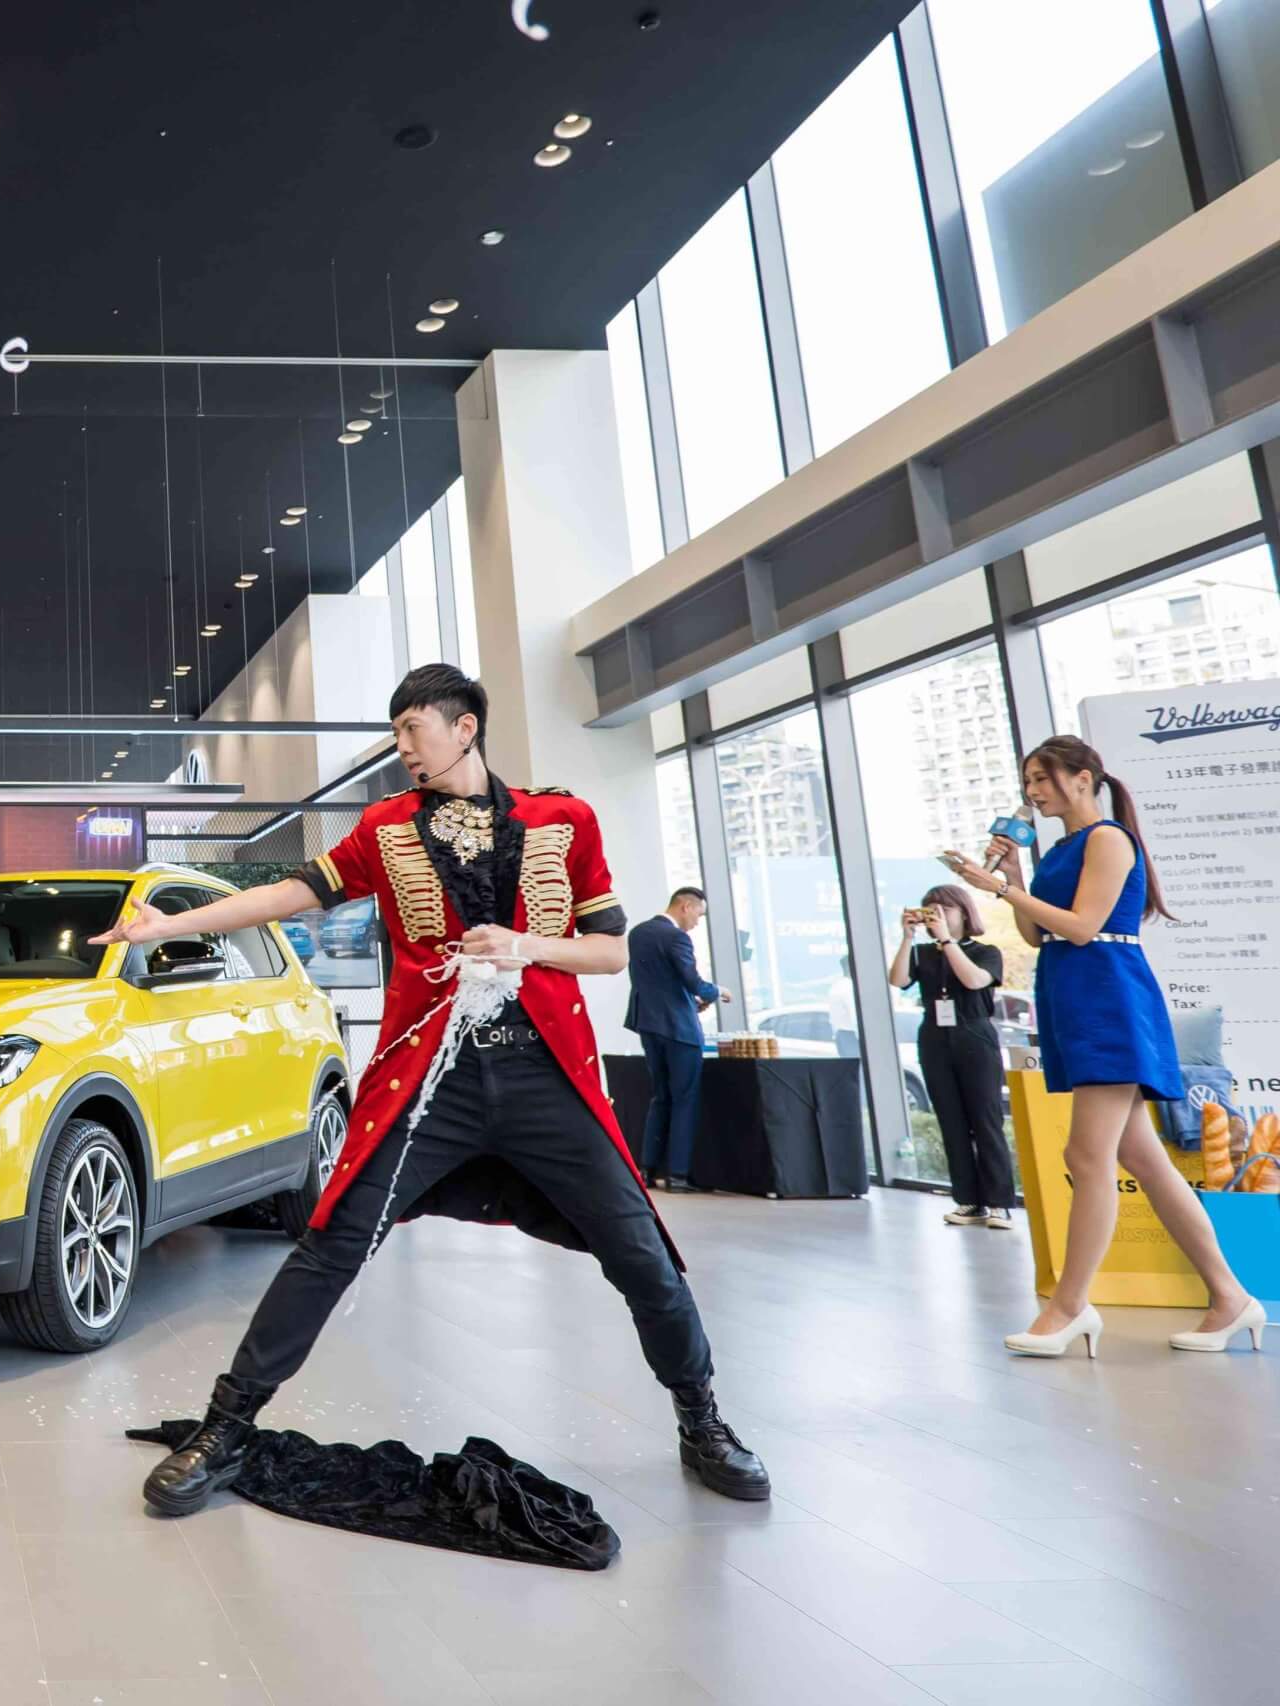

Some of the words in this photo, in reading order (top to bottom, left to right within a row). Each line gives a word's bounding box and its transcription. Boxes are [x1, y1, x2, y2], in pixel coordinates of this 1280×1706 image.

[1144, 803, 1177, 811] Safety
[1152, 854, 1173, 862] Fun
[1175, 853, 1187, 861] to
[1189, 852, 1217, 860] Drive
[1165, 919, 1208, 929] Colorful
[1169, 983, 1211, 993] Price:
[1171, 999, 1202, 1009] Tax:
